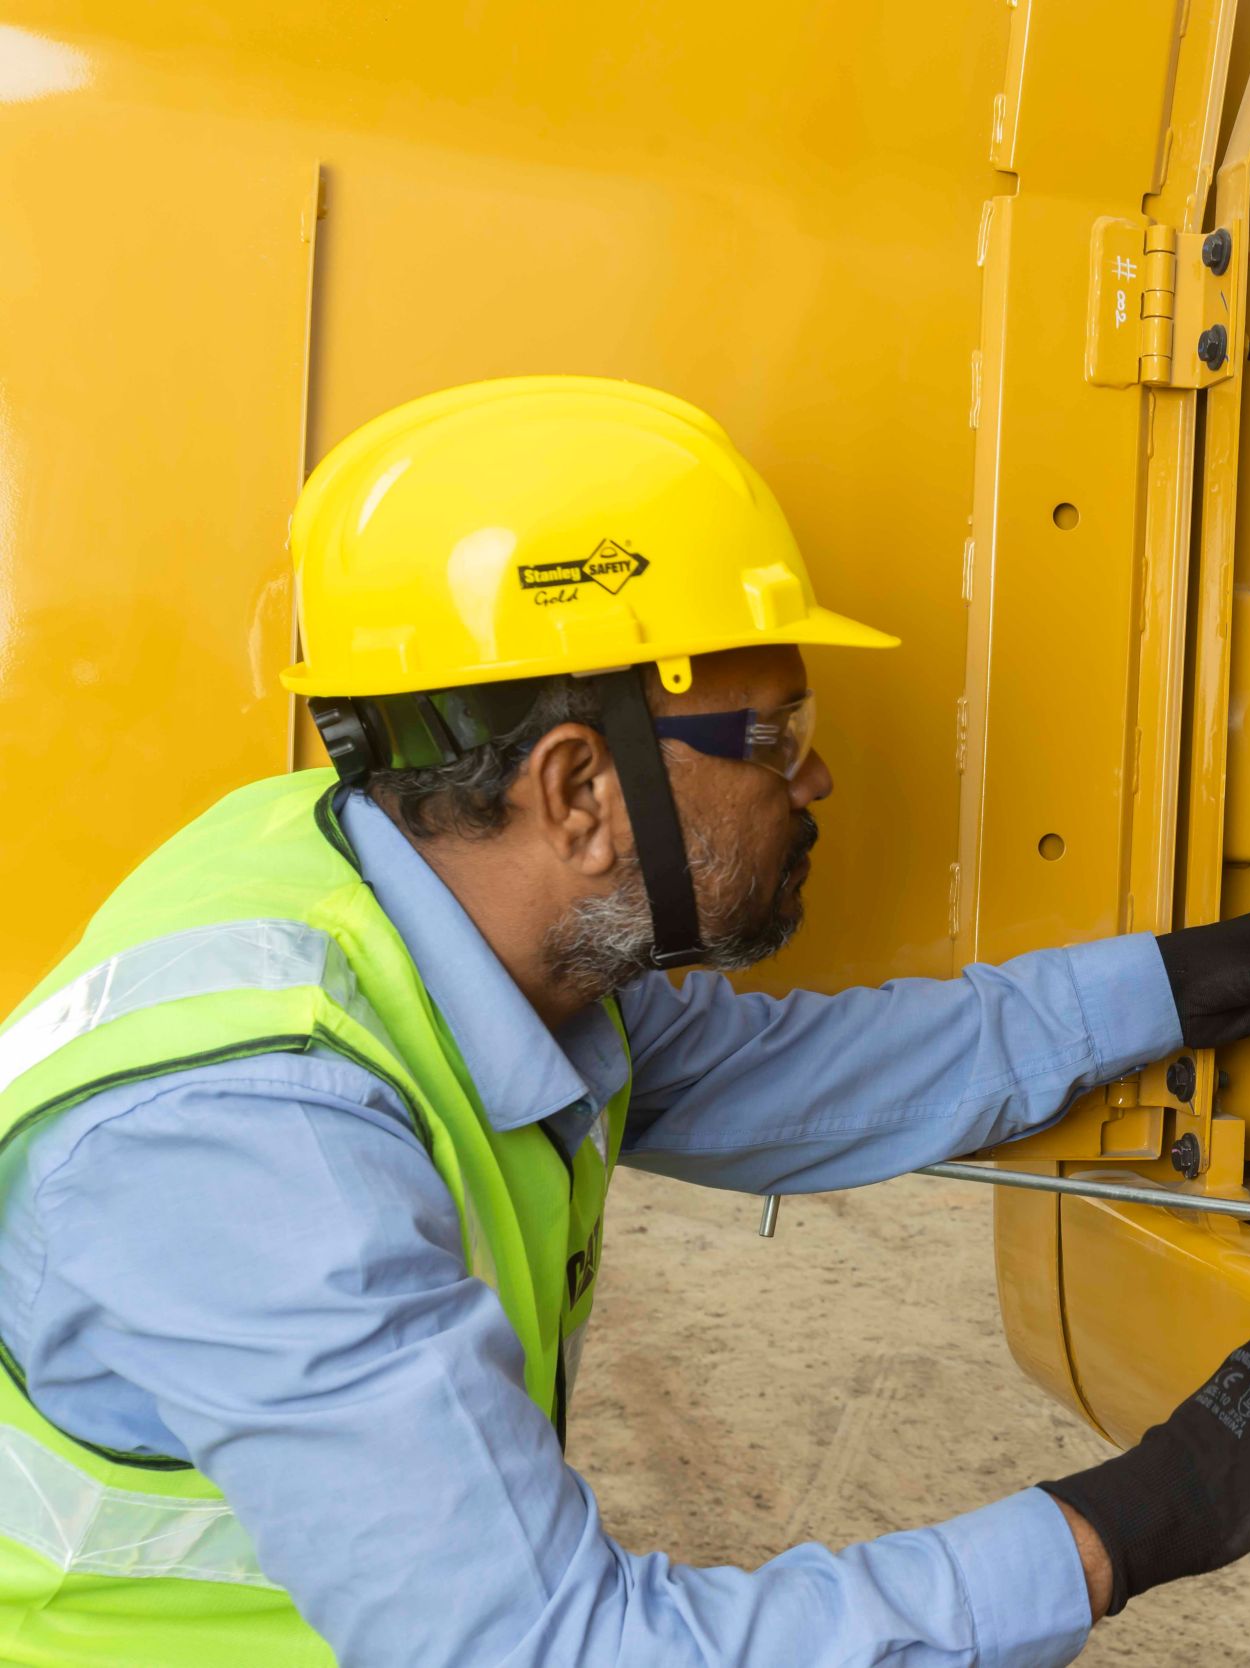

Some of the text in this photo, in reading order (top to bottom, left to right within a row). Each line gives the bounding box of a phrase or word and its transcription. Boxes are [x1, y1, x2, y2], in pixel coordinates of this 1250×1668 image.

[524, 560, 632, 584] Stanley SAFETY
[533, 587, 579, 608] Gold
[1218, 1411, 1244, 1439] CHINA
